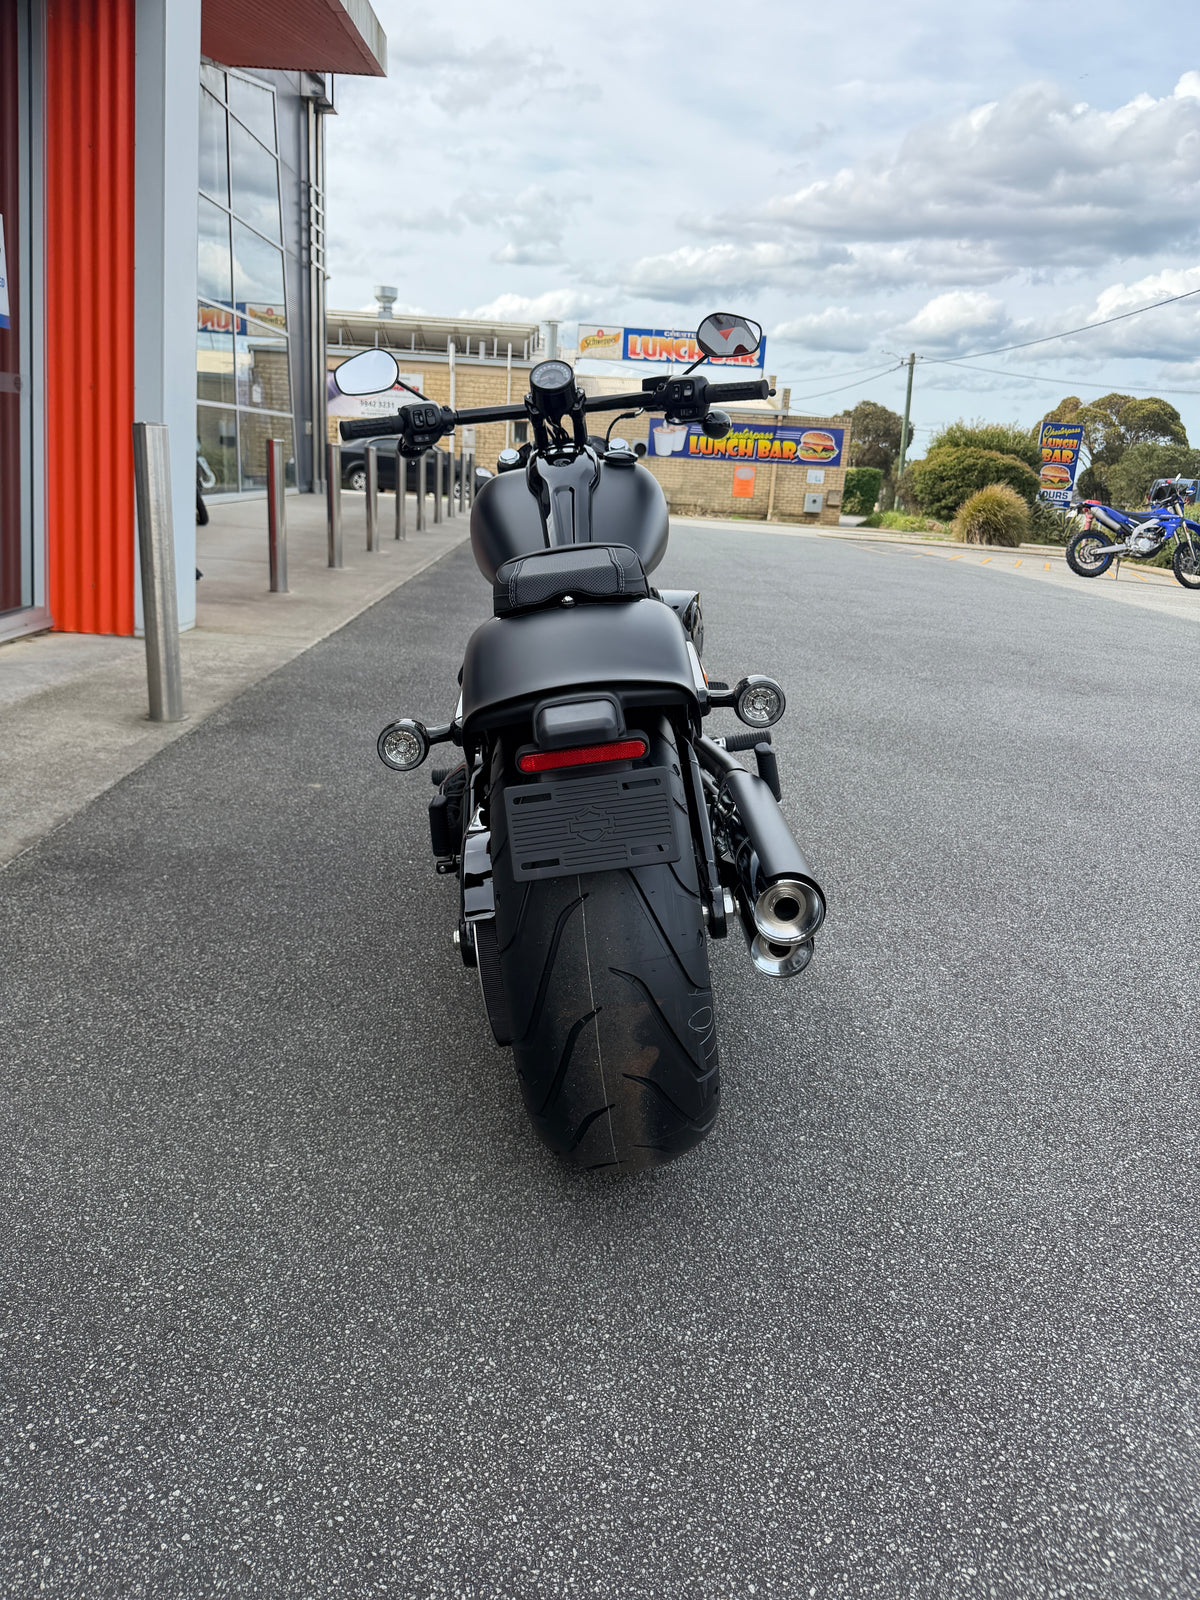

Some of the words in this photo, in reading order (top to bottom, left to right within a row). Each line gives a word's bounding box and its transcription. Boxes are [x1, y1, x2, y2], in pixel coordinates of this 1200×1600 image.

[628, 335, 706, 361] LUNCH
[689, 435, 755, 457] LUNCH
[757, 440, 797, 460] BAR
[1042, 438, 1078, 449] LUNCH
[1042, 448, 1074, 463] BAR
